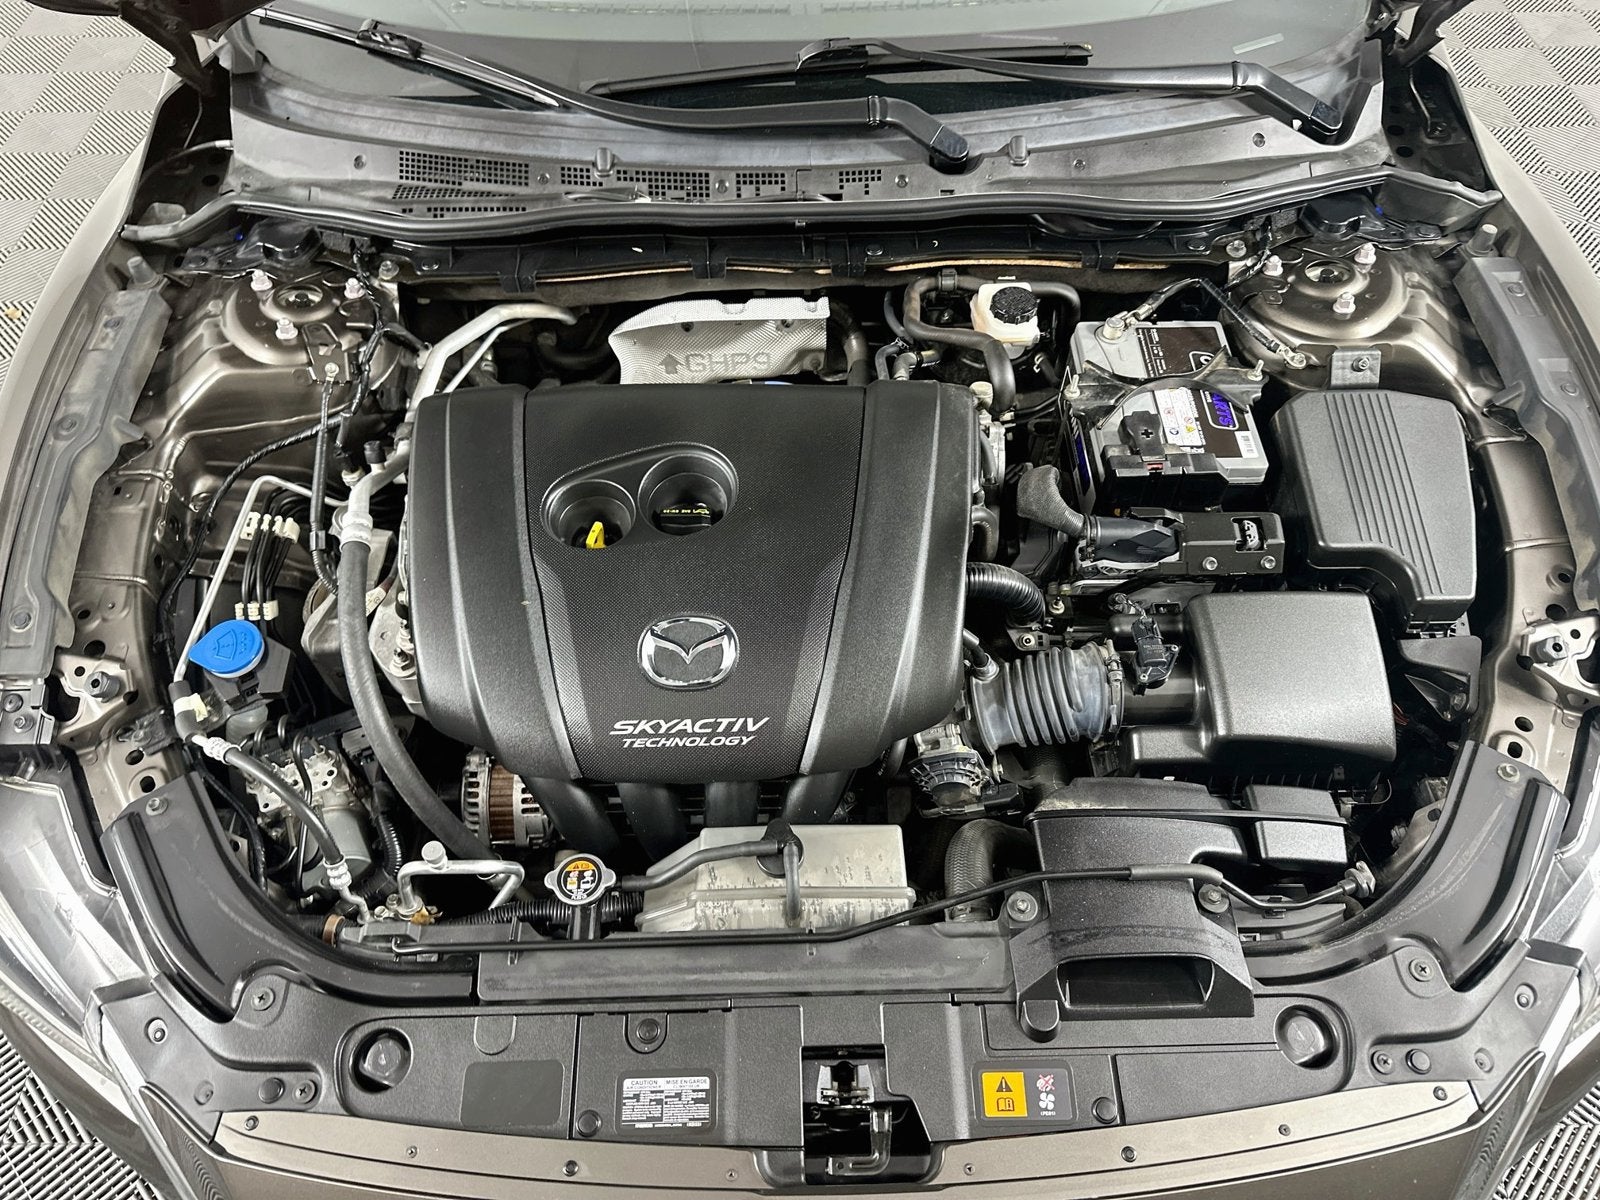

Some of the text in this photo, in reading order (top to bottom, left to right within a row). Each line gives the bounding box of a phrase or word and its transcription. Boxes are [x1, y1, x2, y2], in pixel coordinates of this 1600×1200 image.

[686, 353, 771, 374] GHP9
[1212, 392, 1233, 426] ARTS
[609, 717, 770, 735] SKYACTIV
[622, 736, 756, 748] TECHNOLOGY
